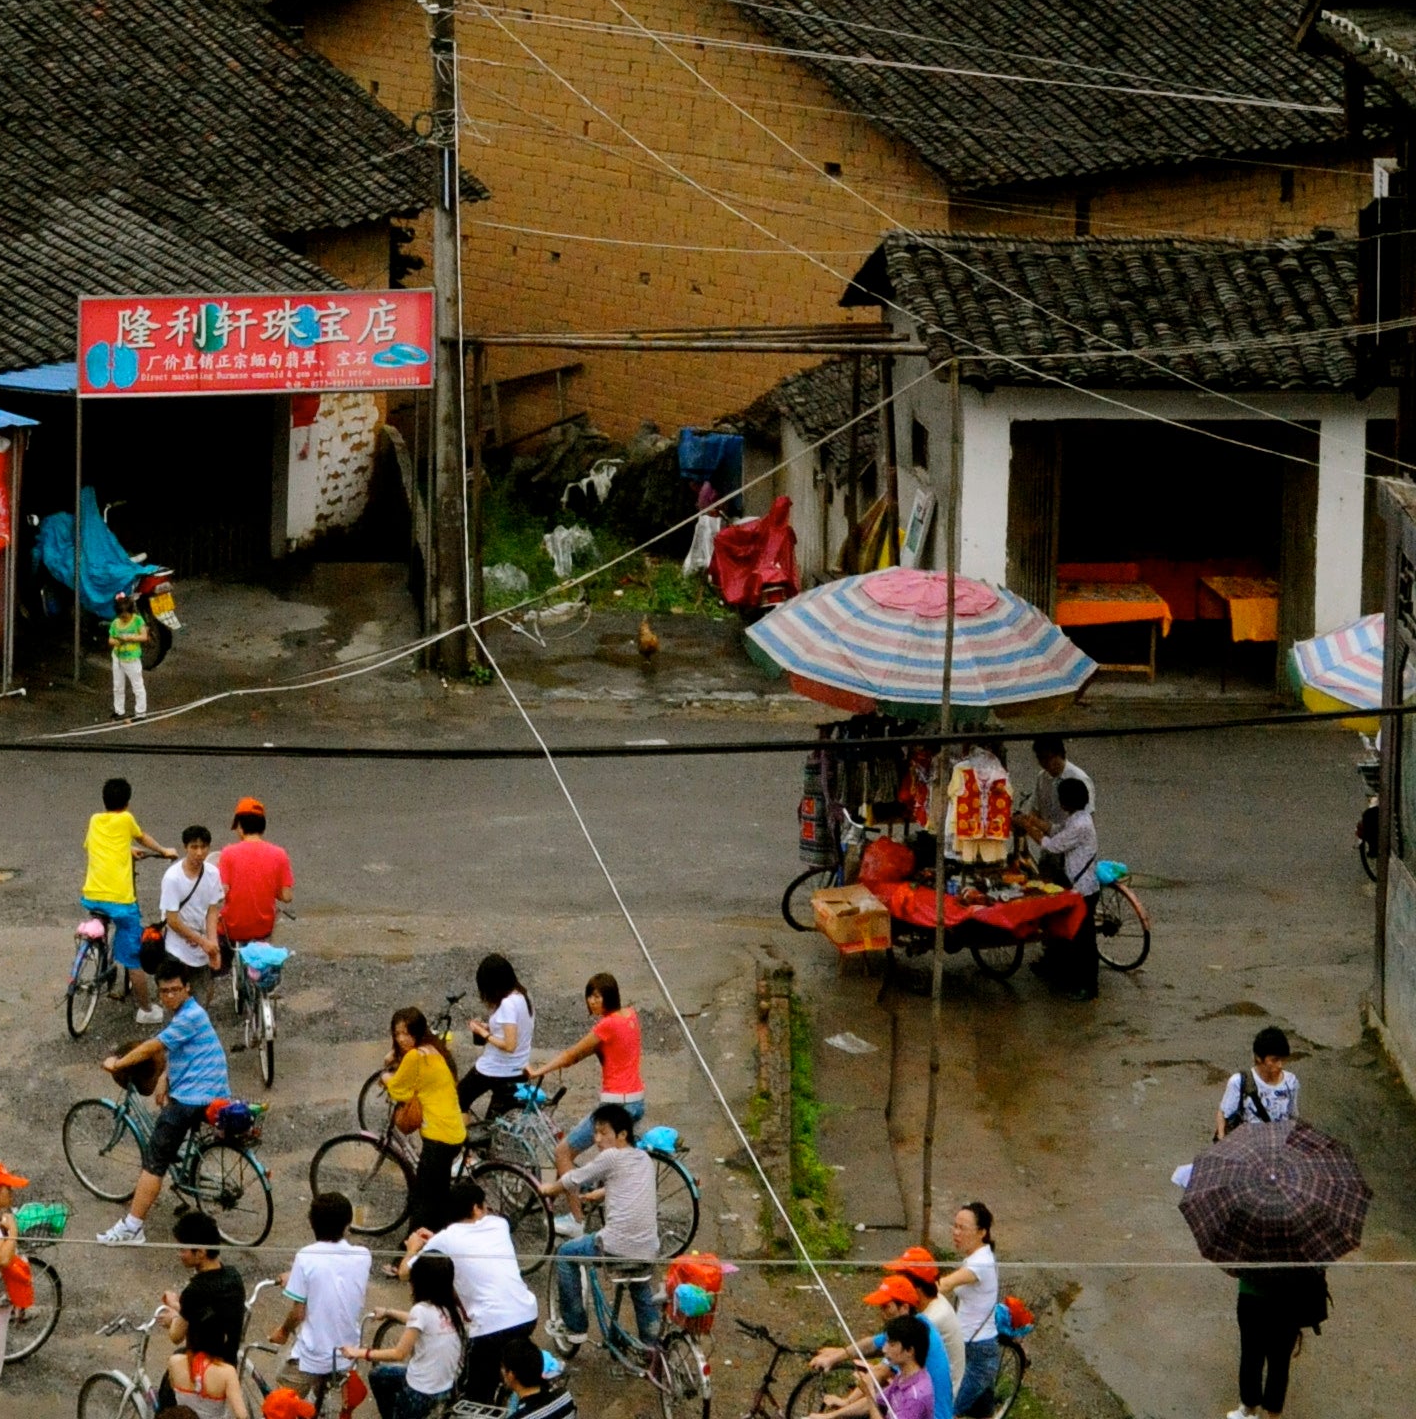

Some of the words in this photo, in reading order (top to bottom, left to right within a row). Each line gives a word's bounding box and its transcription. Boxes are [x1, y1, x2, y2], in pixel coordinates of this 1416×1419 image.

[116, 299, 398, 350] 隆利轩珠宝店
